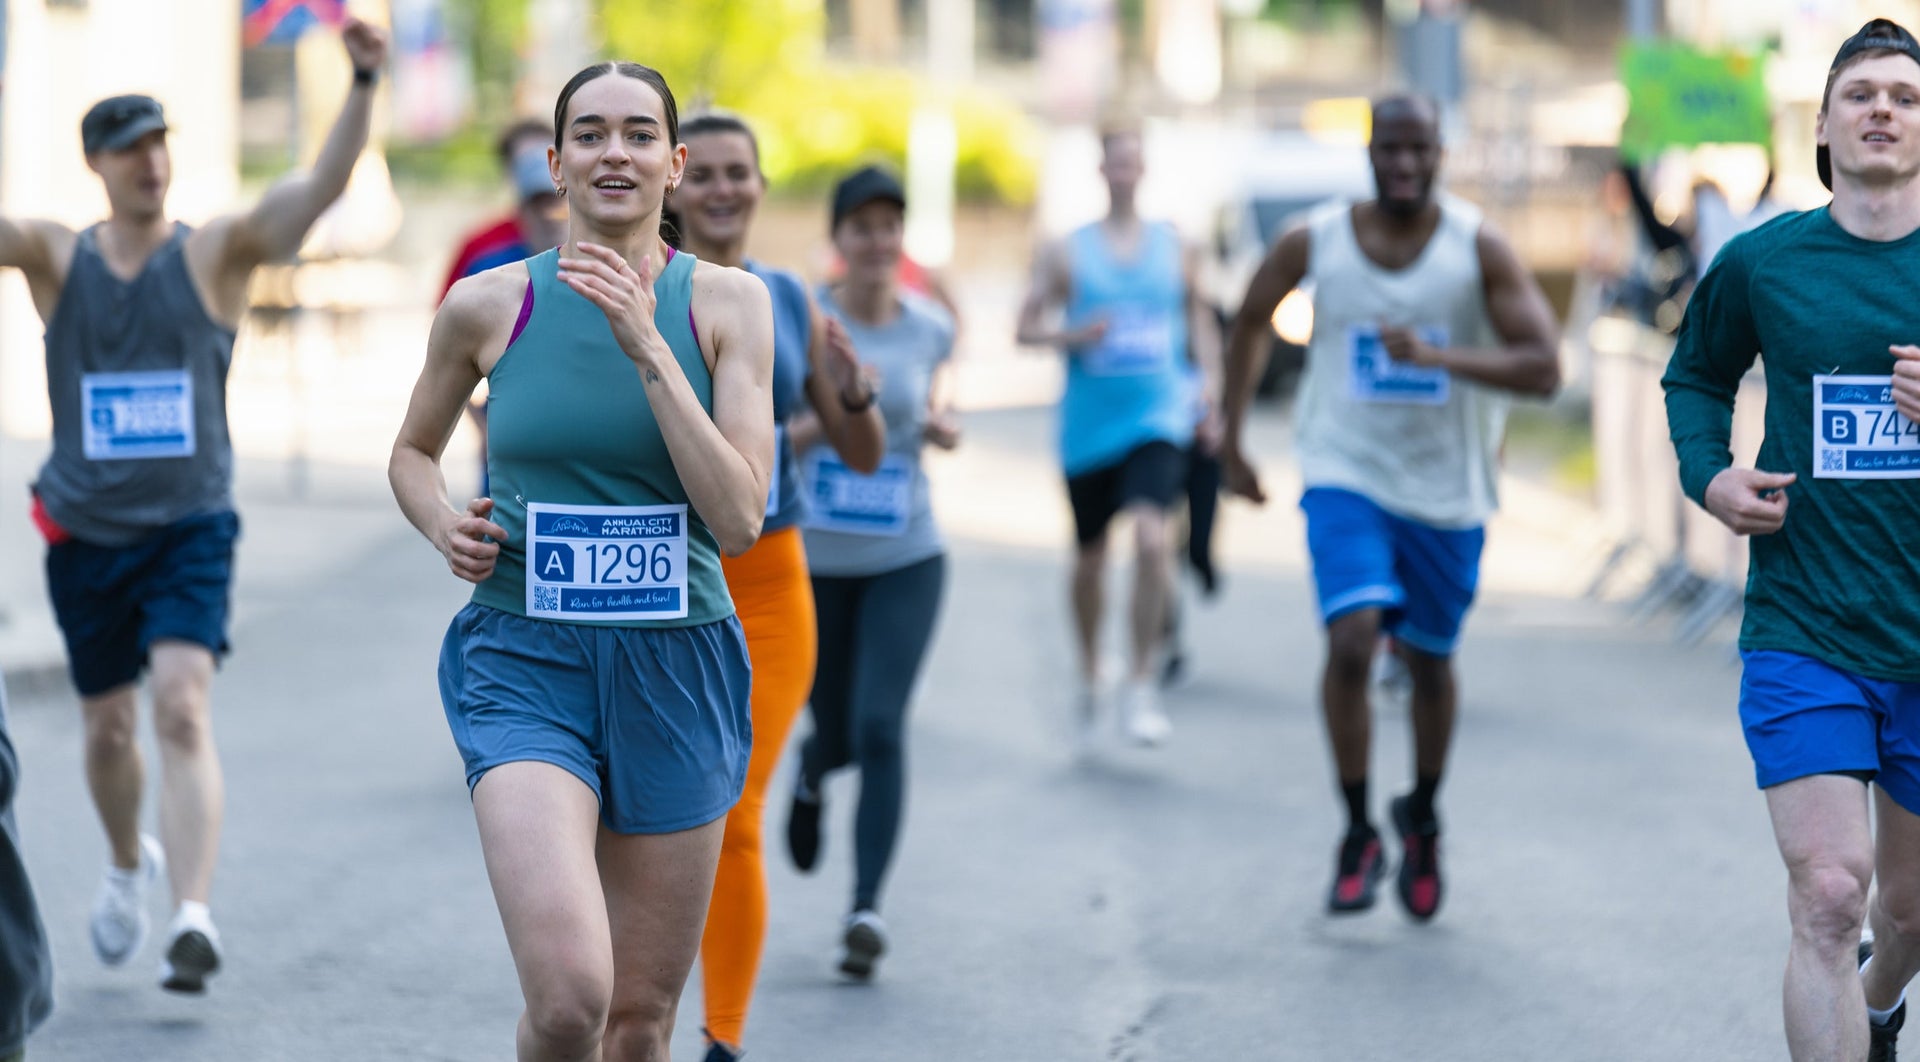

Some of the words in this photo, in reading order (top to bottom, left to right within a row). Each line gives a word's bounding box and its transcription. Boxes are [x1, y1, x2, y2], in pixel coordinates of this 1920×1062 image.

[1832, 416, 1849, 439] B
[602, 526, 672, 536] MARATHON
[648, 517, 672, 526] CITY
[544, 550, 565, 575] A
[586, 543, 672, 584] 1296
[570, 597, 591, 609] Run
[592, 597, 603, 608] for
[608, 595, 632, 607] health
[634, 593, 650, 605] and
[651, 591, 671, 603] fun!
